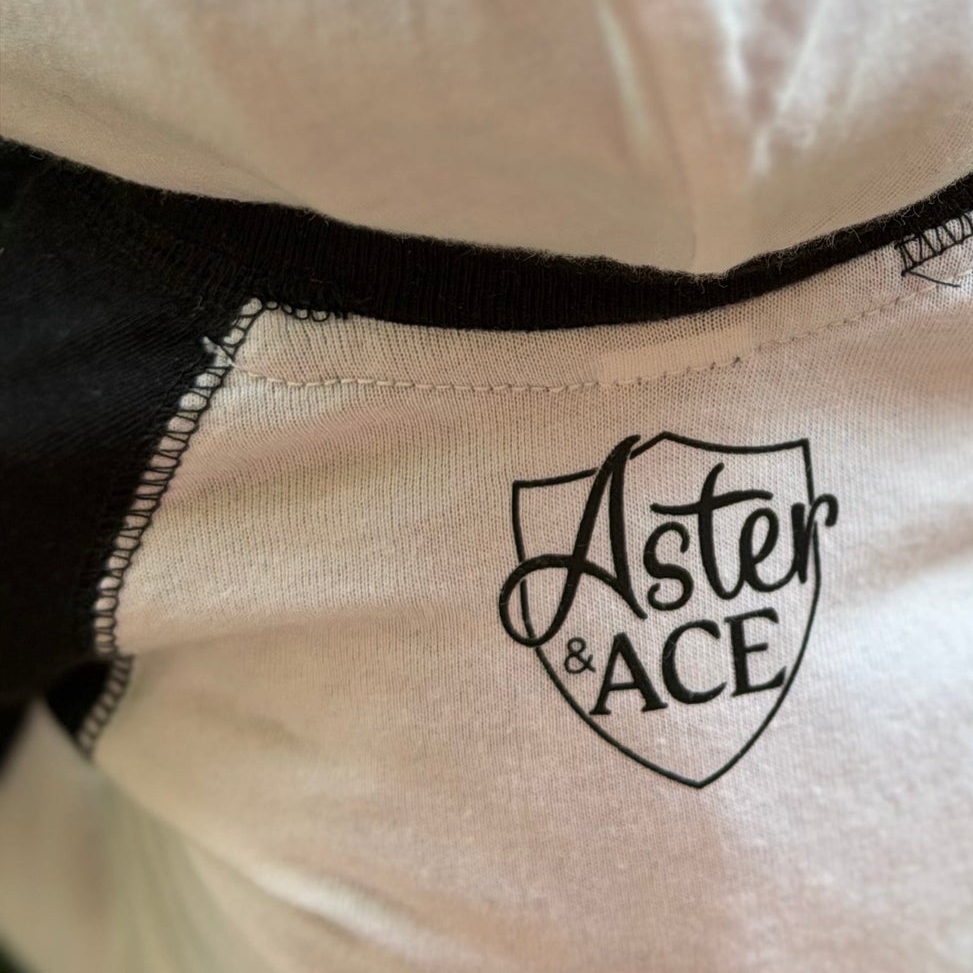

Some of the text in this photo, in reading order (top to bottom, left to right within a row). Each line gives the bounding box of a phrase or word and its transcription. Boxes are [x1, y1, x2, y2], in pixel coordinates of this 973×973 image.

[500, 434, 839, 647] Aster
[563, 607, 787, 716] & ACE
